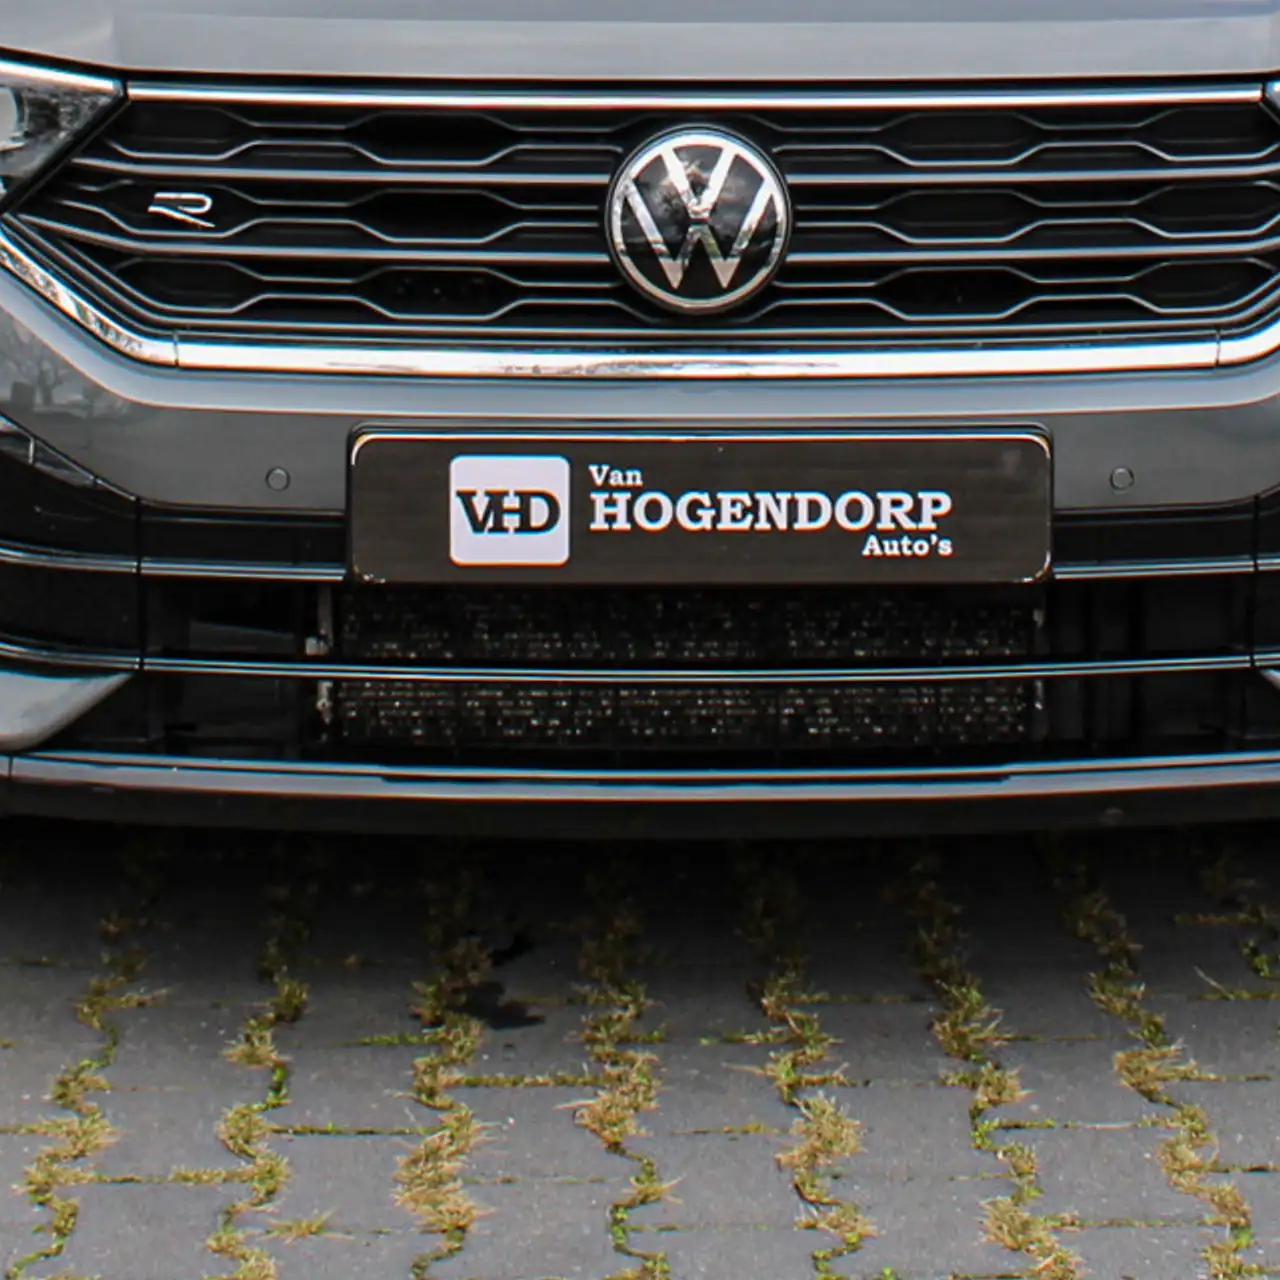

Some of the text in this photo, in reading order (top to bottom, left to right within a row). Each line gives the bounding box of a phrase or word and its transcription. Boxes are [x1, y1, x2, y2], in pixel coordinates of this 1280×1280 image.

[588, 464, 644, 487] Van
[455, 489, 561, 535] VHD
[589, 490, 953, 532] HOGENDORP
[861, 532, 954, 557] Auto's
